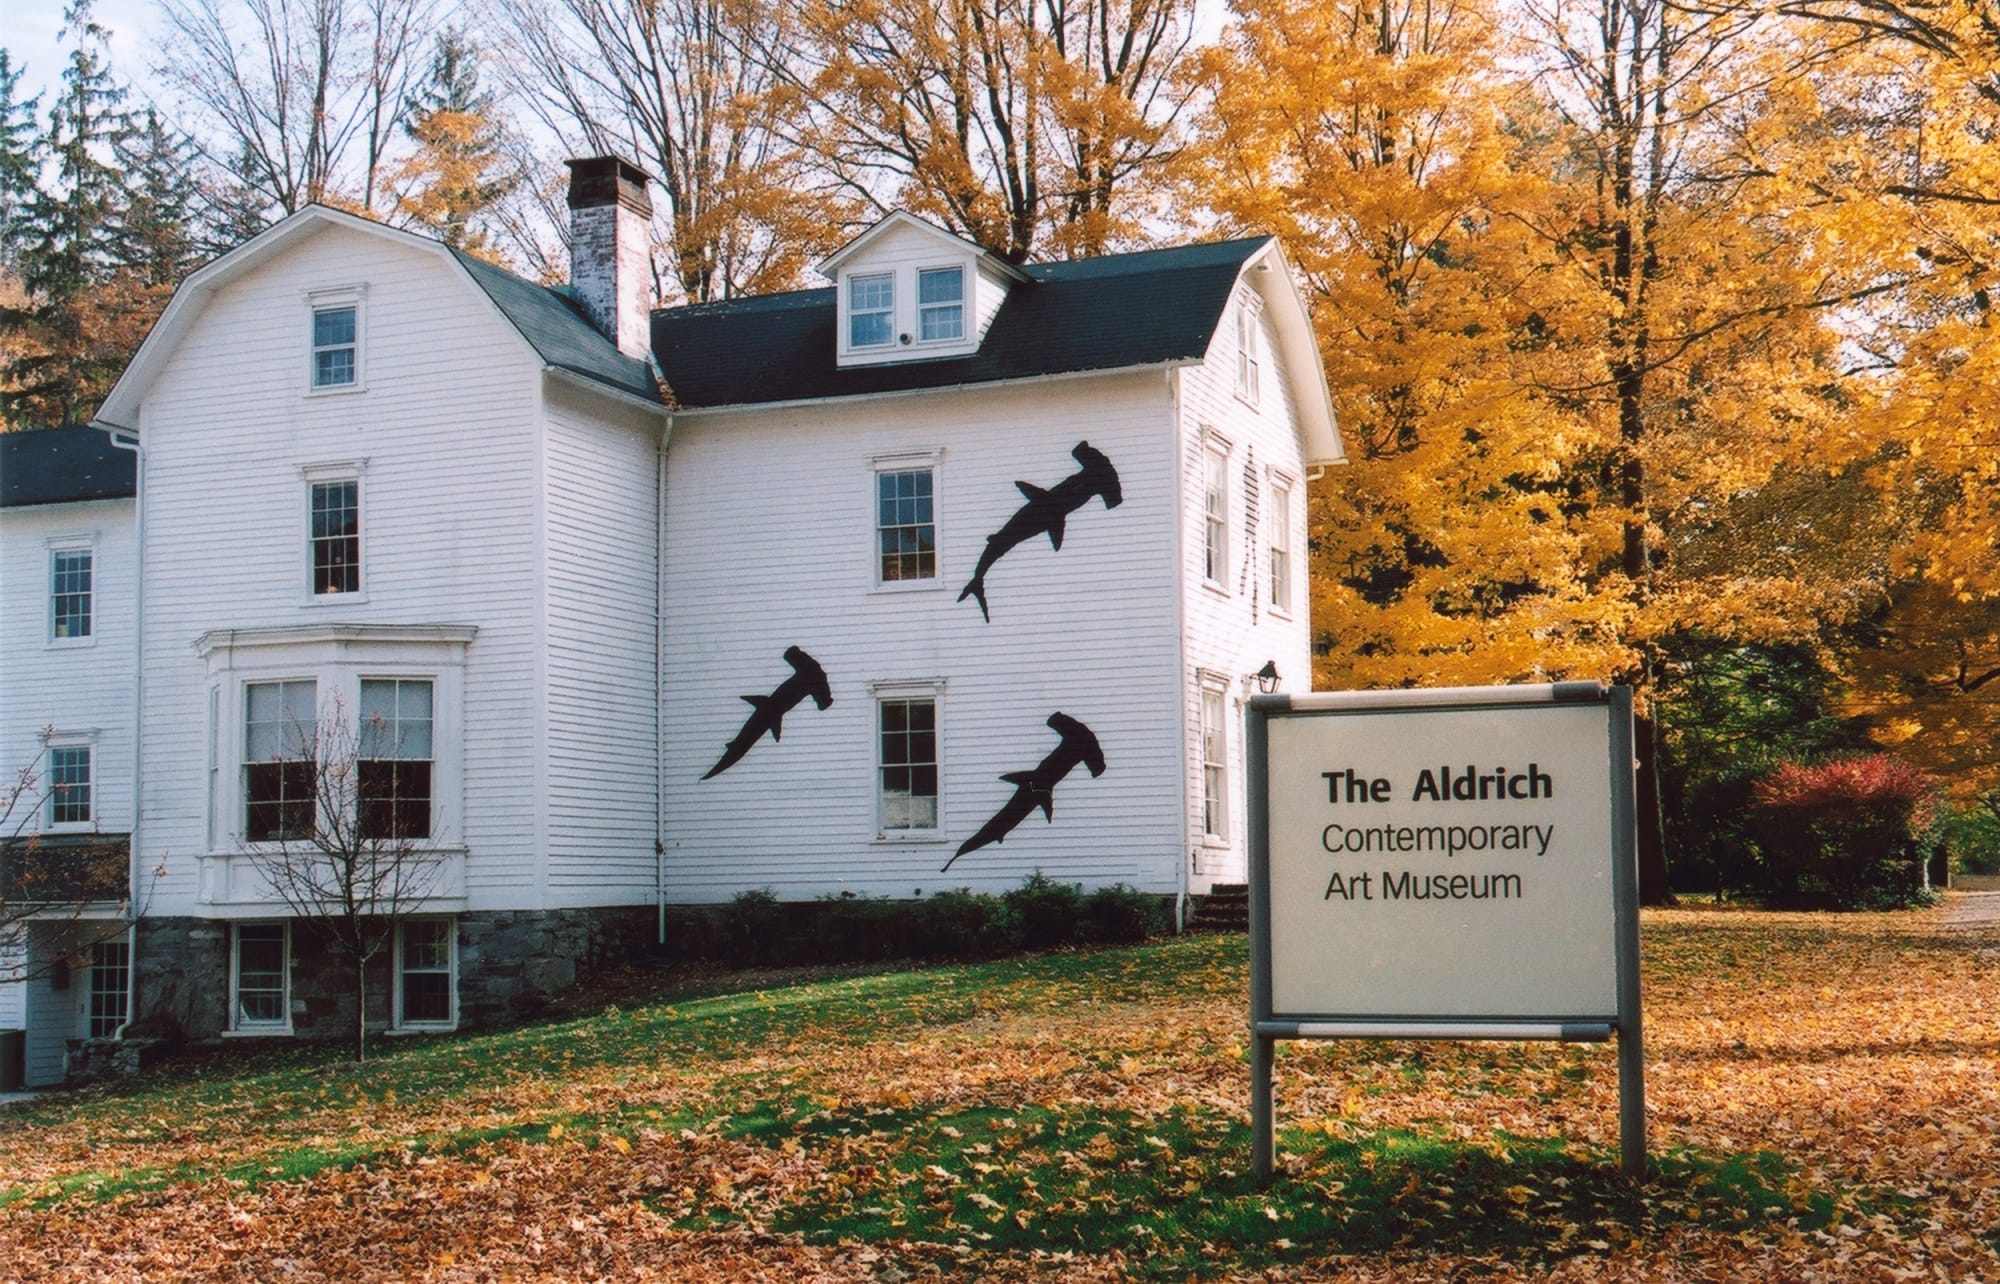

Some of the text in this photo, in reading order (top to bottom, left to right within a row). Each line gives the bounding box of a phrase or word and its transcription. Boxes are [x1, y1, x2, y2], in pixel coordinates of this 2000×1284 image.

[1321, 764, 1553, 803] The Aldrich
[1323, 823, 1554, 857] Contemporary
[1324, 872, 1522, 900] Art Museum
